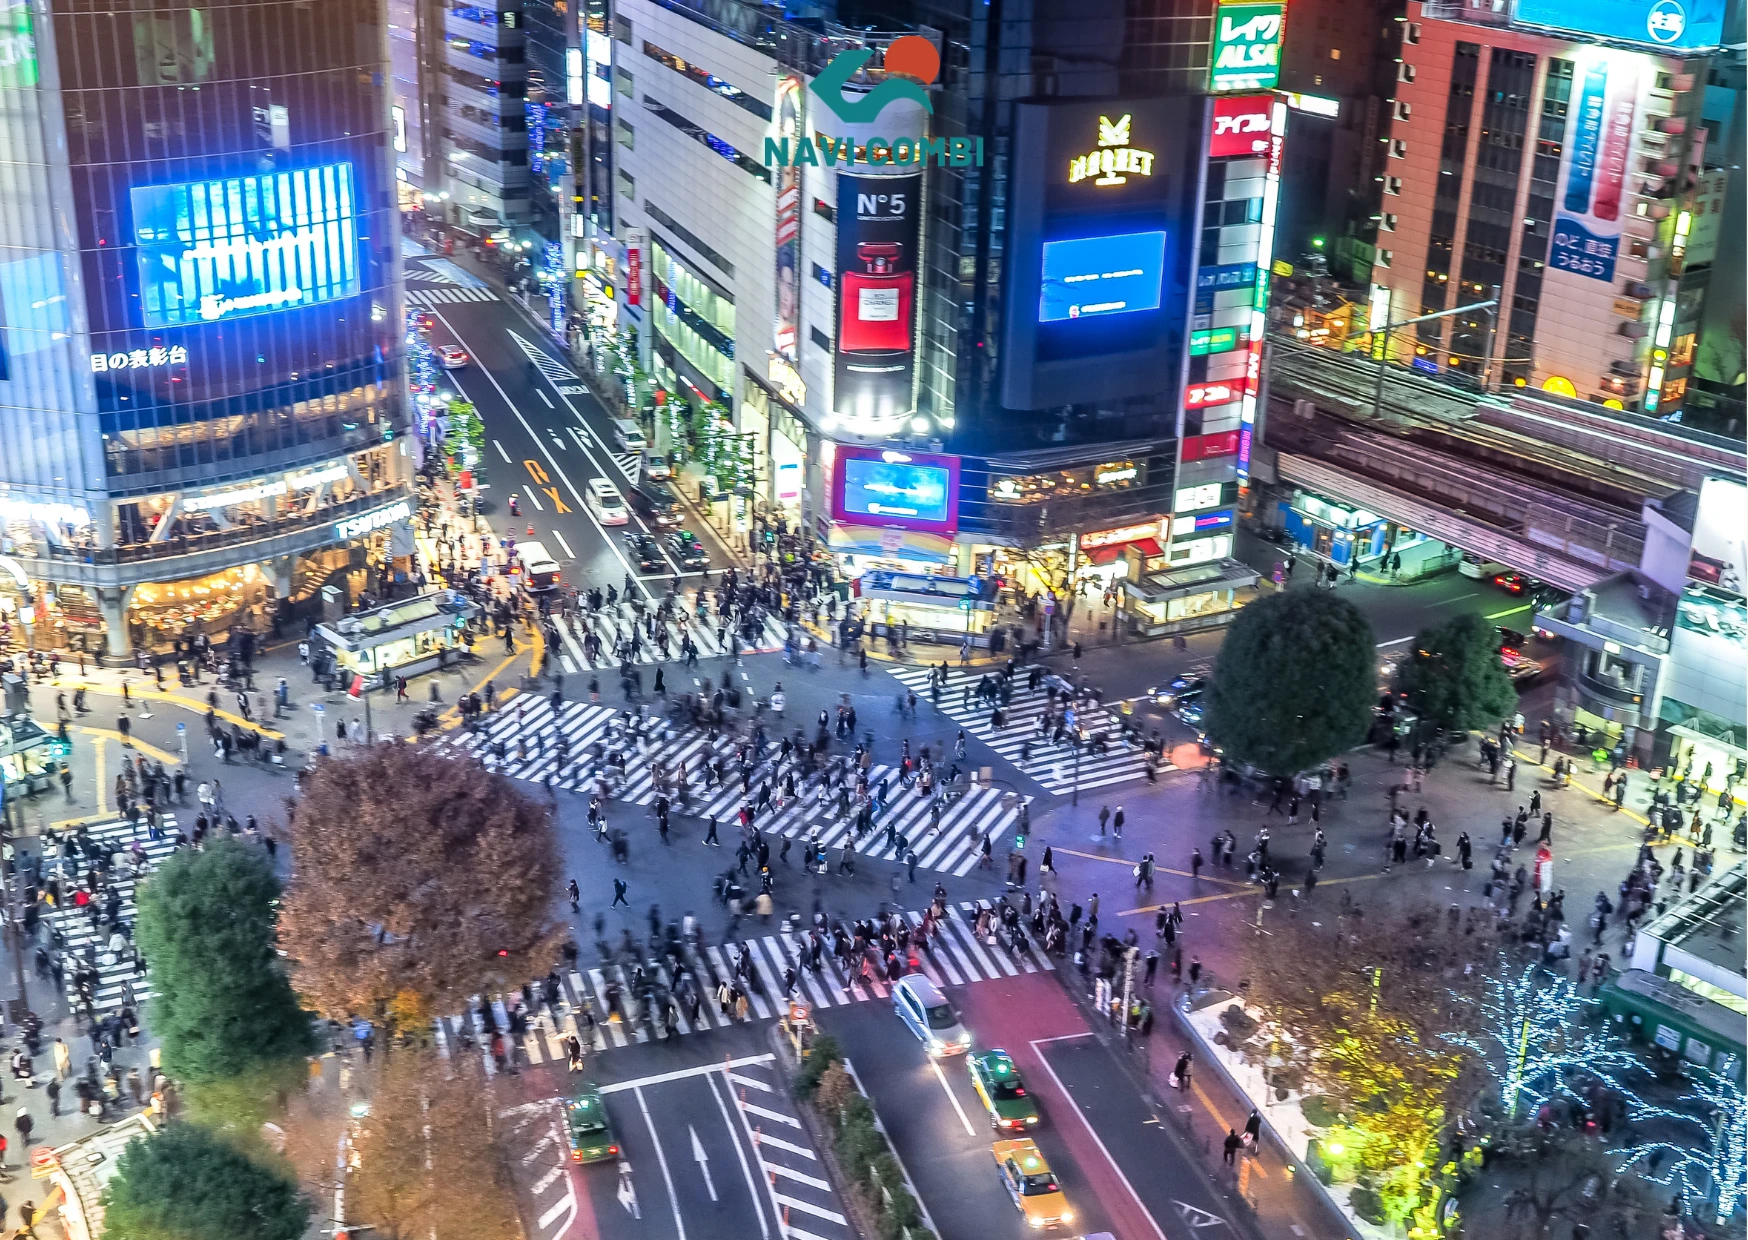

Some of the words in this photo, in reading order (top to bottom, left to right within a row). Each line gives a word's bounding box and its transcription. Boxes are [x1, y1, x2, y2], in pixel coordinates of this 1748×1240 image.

[1220, 14, 1281, 42] レイク
[1215, 43, 1279, 68] ALSA
[1557, 252, 1605, 275] うるおう
[90, 345, 187, 372] 目の表彰台
[336, 502, 411, 539] TSUTAYA
